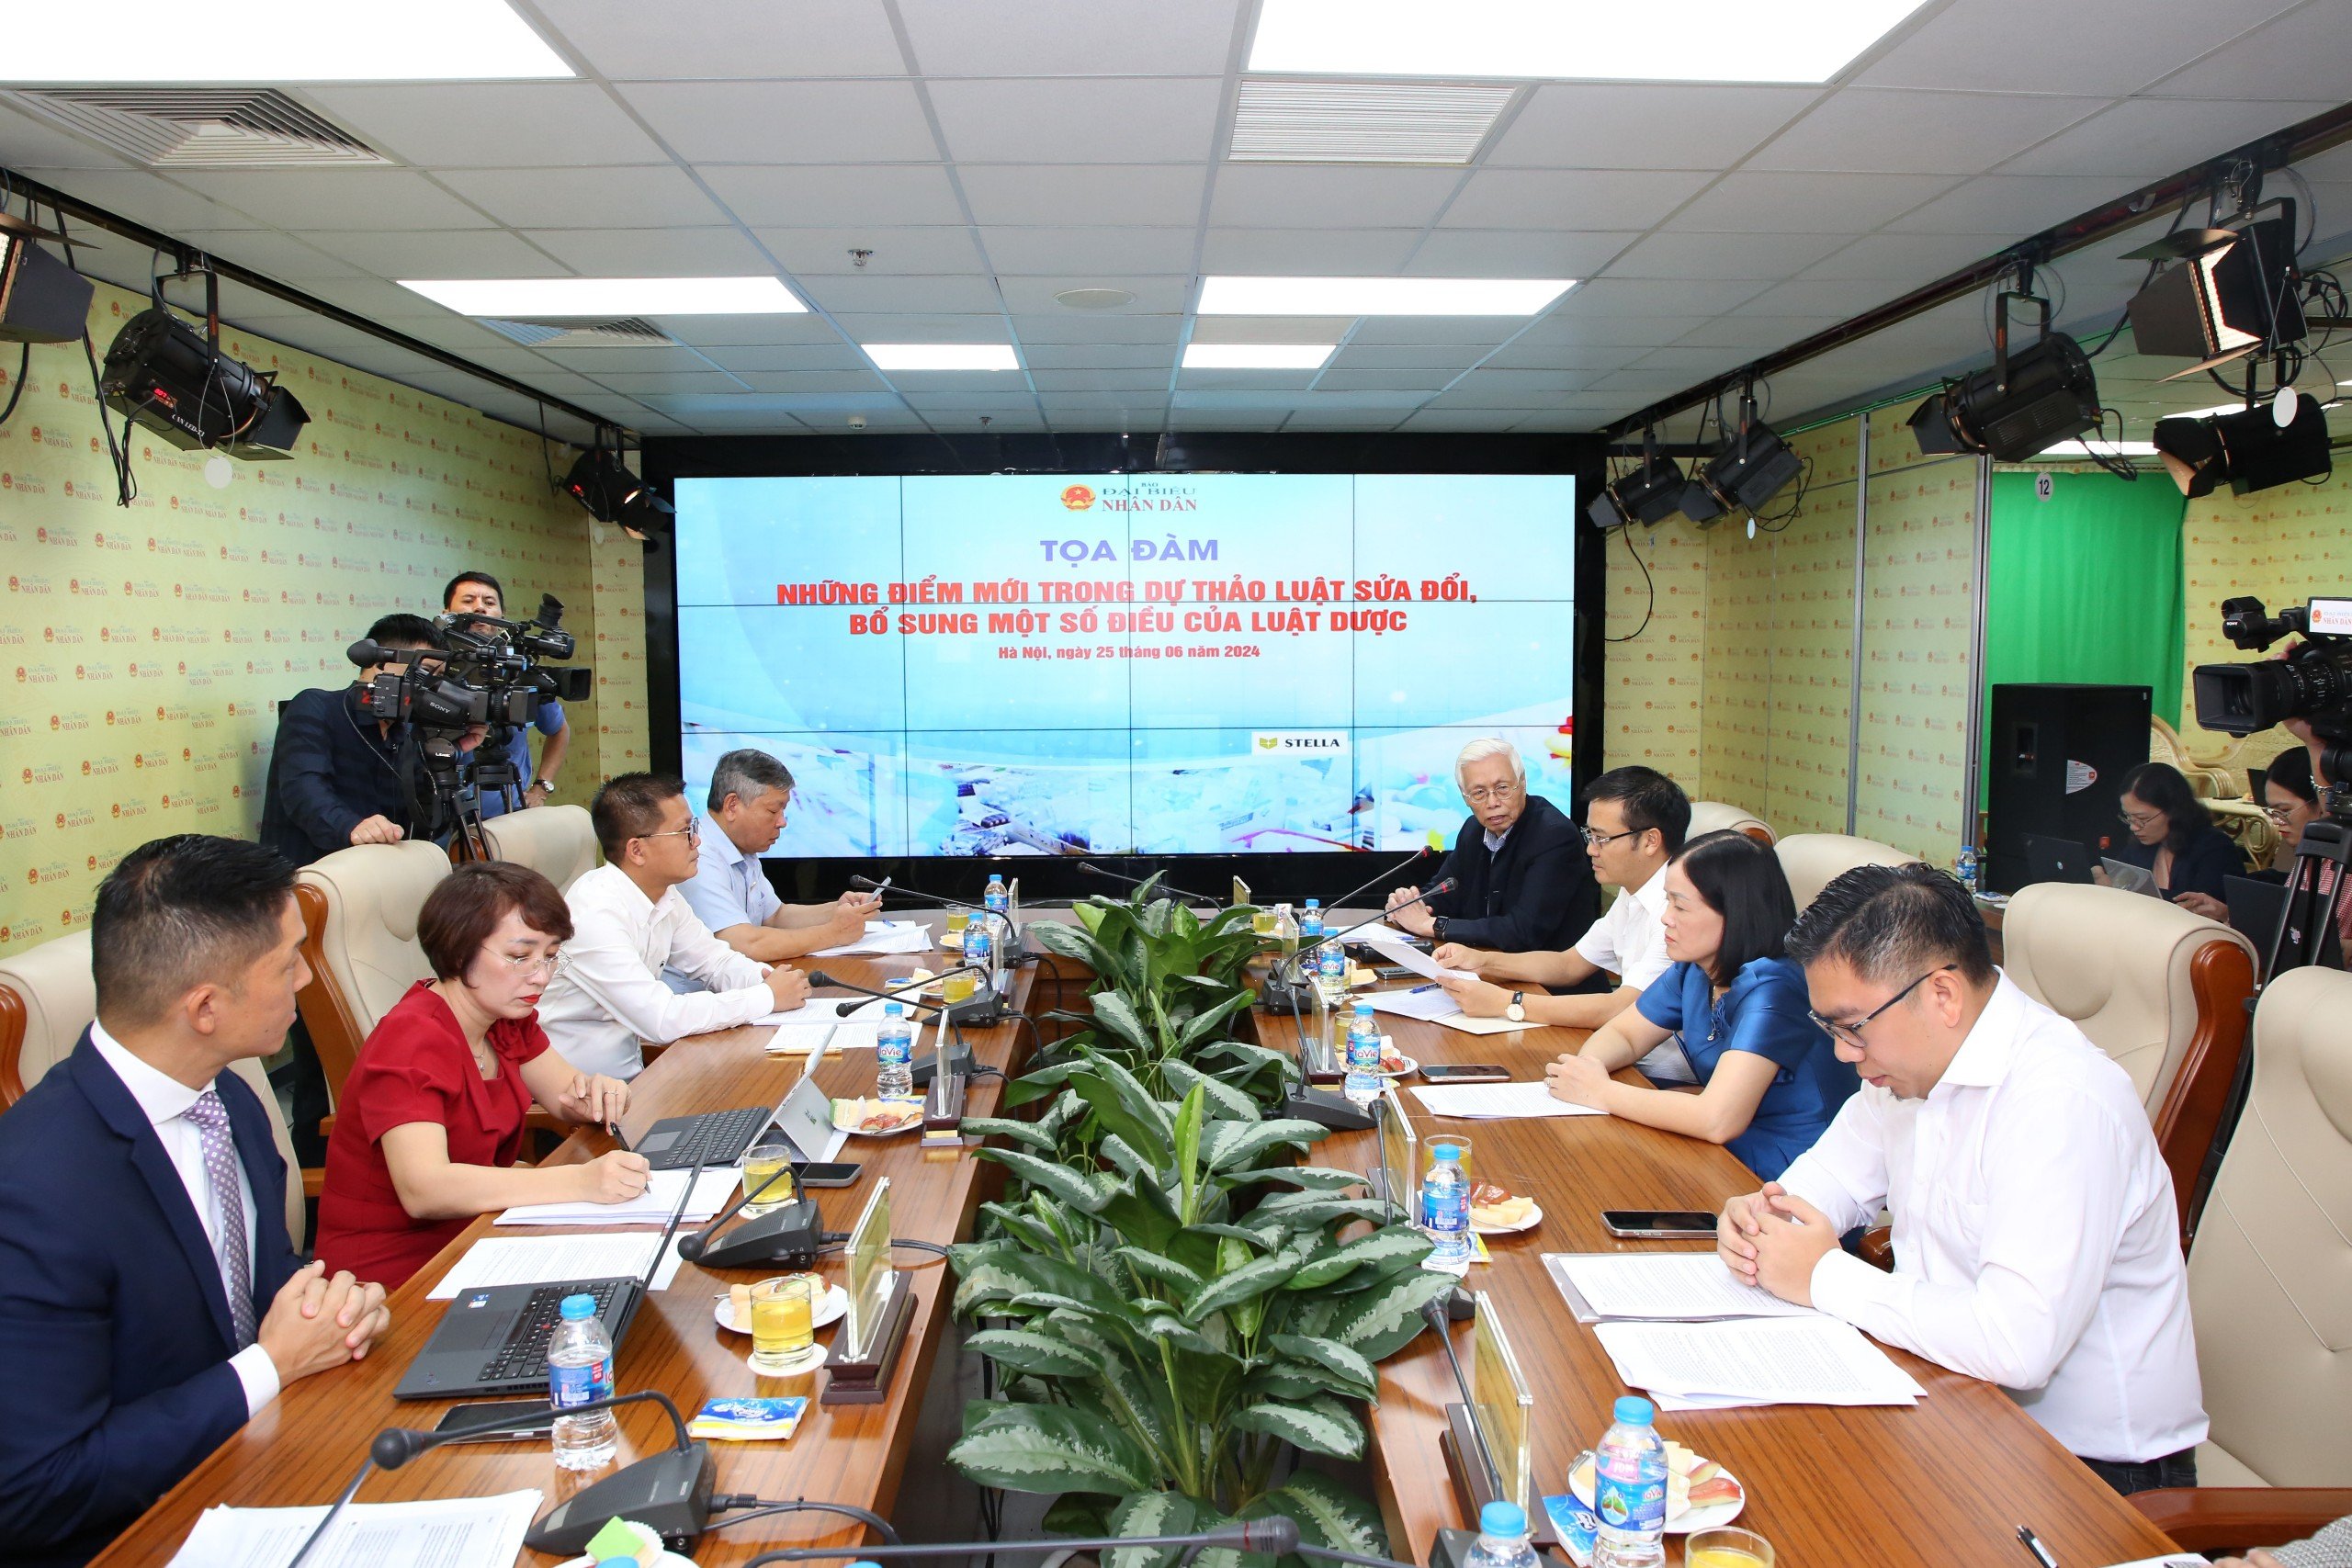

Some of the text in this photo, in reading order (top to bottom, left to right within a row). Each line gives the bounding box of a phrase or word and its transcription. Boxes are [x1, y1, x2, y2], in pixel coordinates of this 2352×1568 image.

[1102, 488, 1139, 497] ĐẠI
[2039, 479, 2050, 495] 12
[1102, 496, 1197, 512] NHÂN DÂN
[1040, 533, 1218, 568] TỌA ĐÀM
[776, 572, 1477, 606] NHỮNG ĐIỂM MỚI TRONG DỰ THẢO LUẬT SỬA ĐỔI,
[849, 605, 1408, 637] BỔ SUNG MỘT SỐ ĐIỀU CỦA LUẬT DƯỢC
[999, 645, 1261, 661] Hà Nội, ngày 25 tháng 06 năm 2024
[429, 701, 450, 714] SONY
[1284, 739, 1340, 748] STELLA
[879, 1046, 902, 1056] laVie
[1355, 1049, 1378, 1058] laVie
